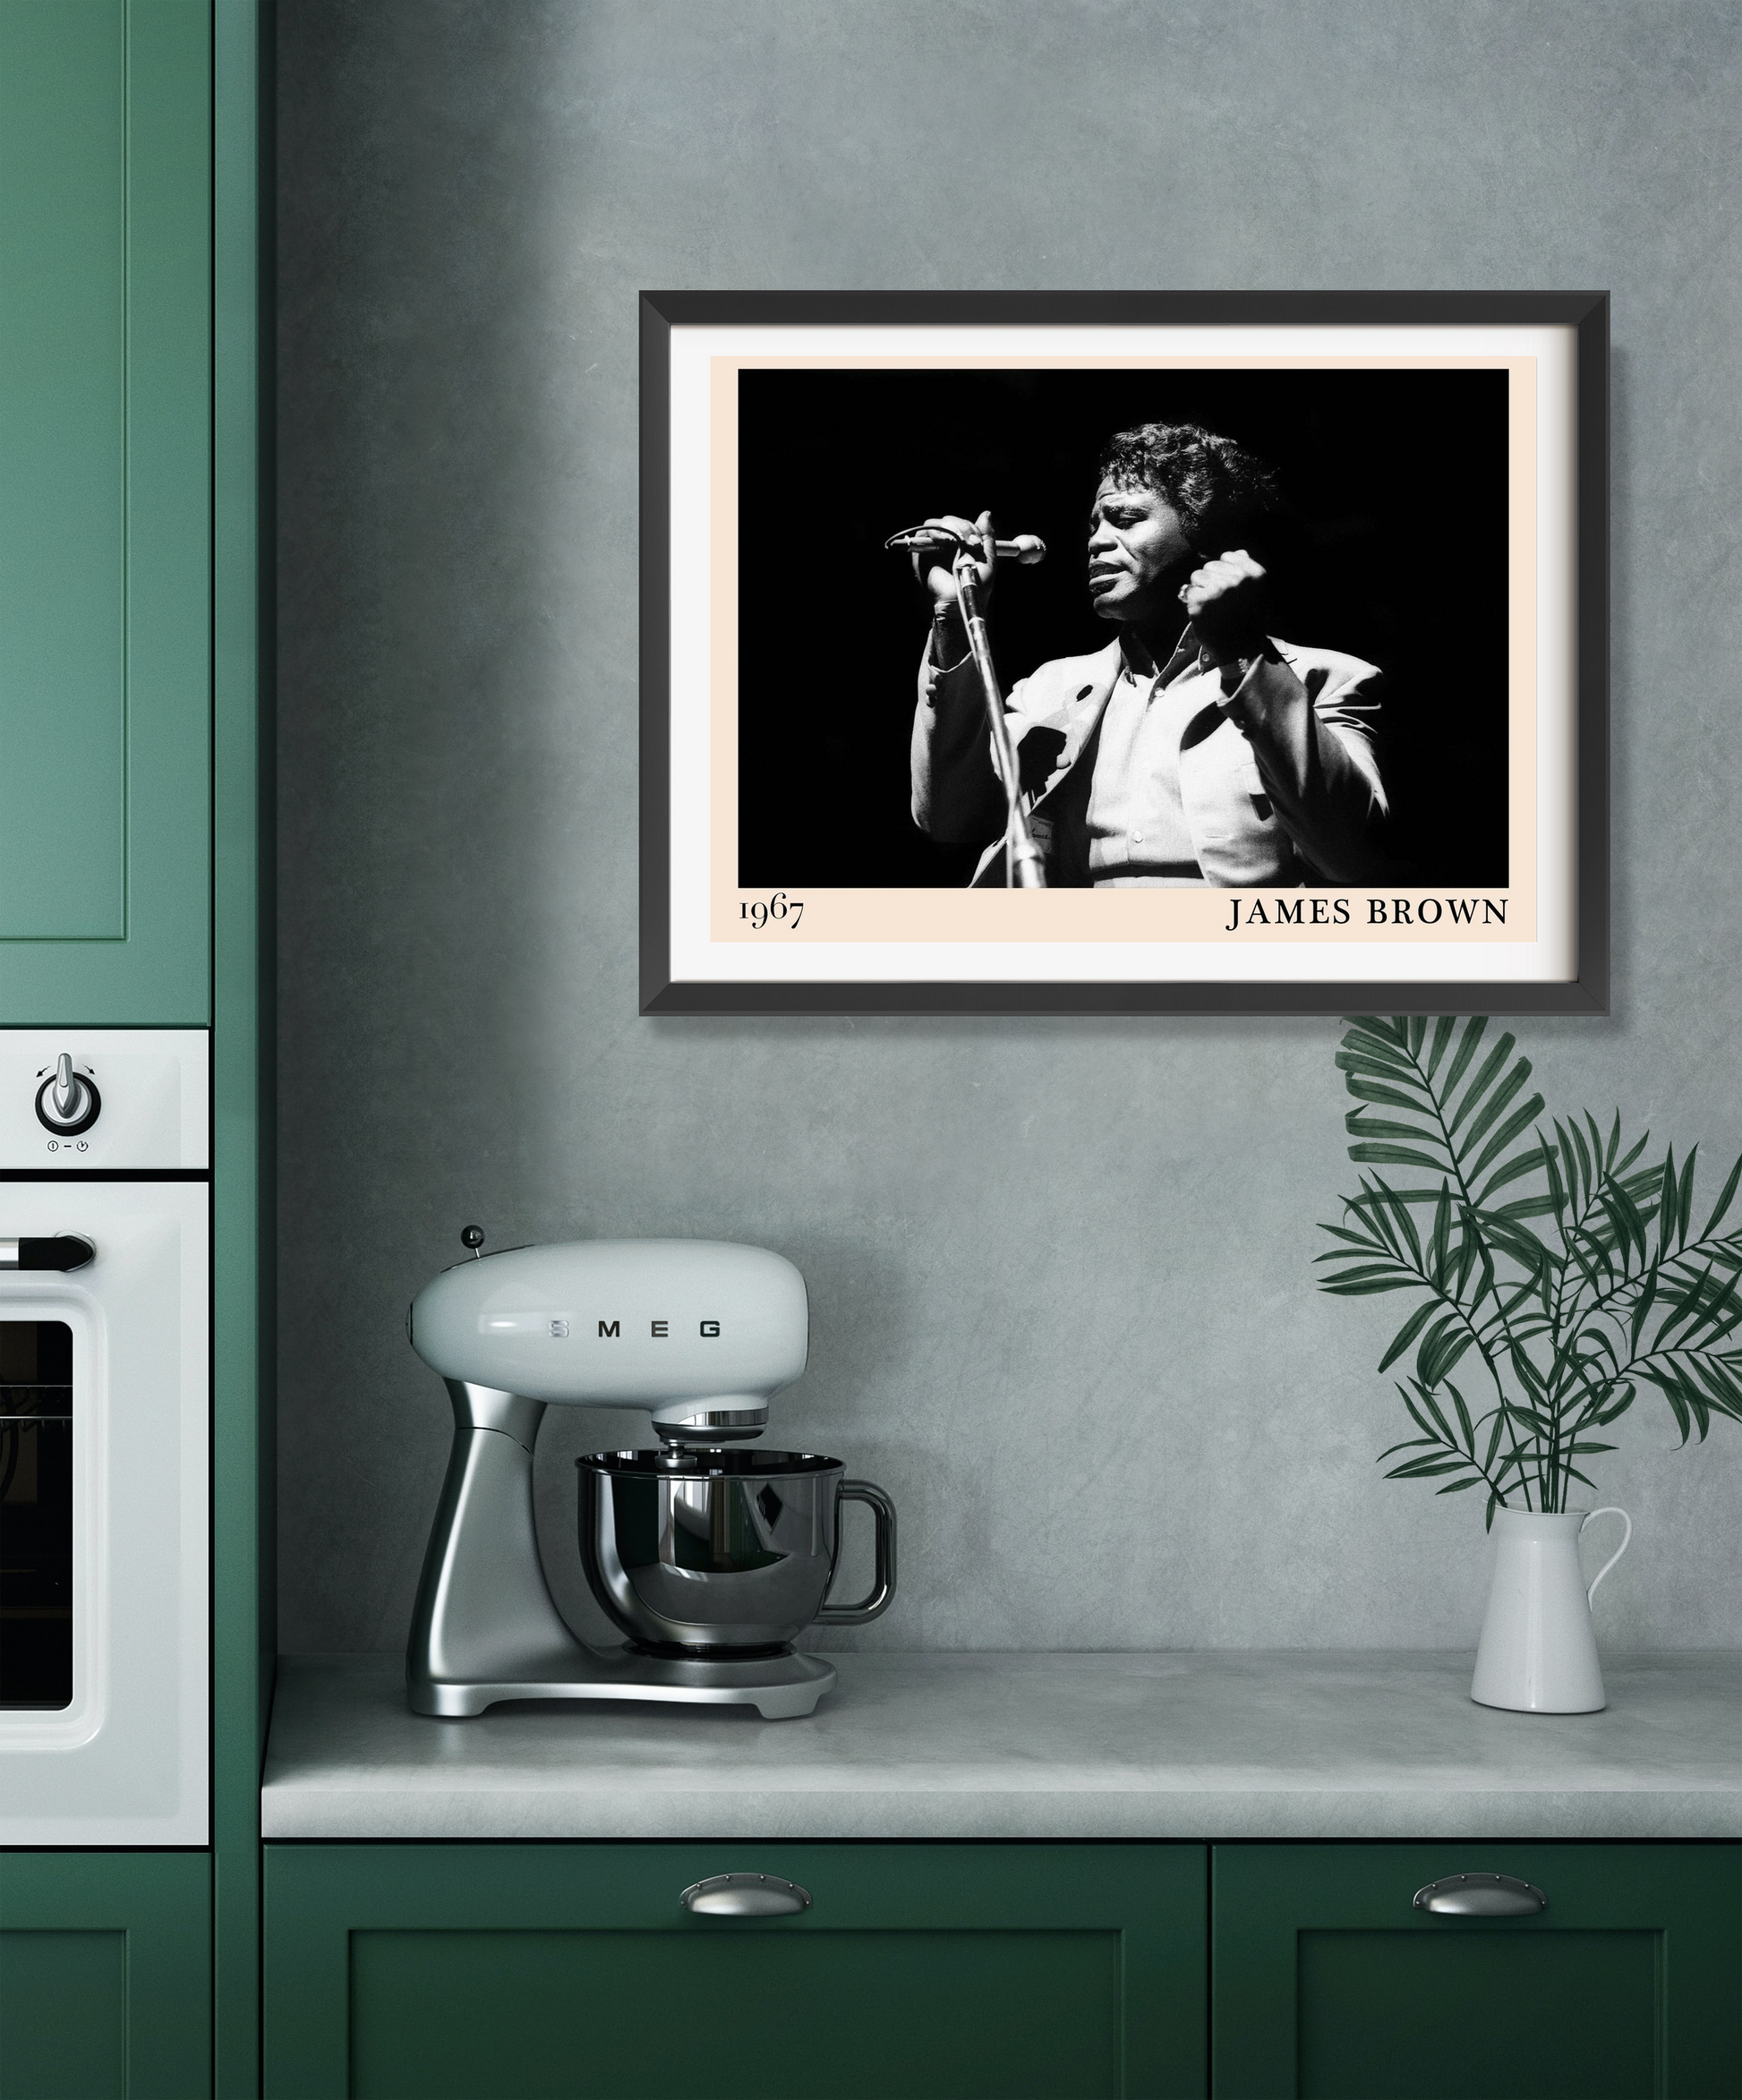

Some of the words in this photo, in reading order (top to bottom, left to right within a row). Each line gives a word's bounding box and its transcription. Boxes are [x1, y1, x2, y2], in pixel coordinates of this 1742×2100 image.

[739, 892, 805, 930] 1967
[1225, 898, 1350, 932] JAMES
[1366, 898, 1510, 926] BROWN
[548, 1319, 722, 1338] SMEG
